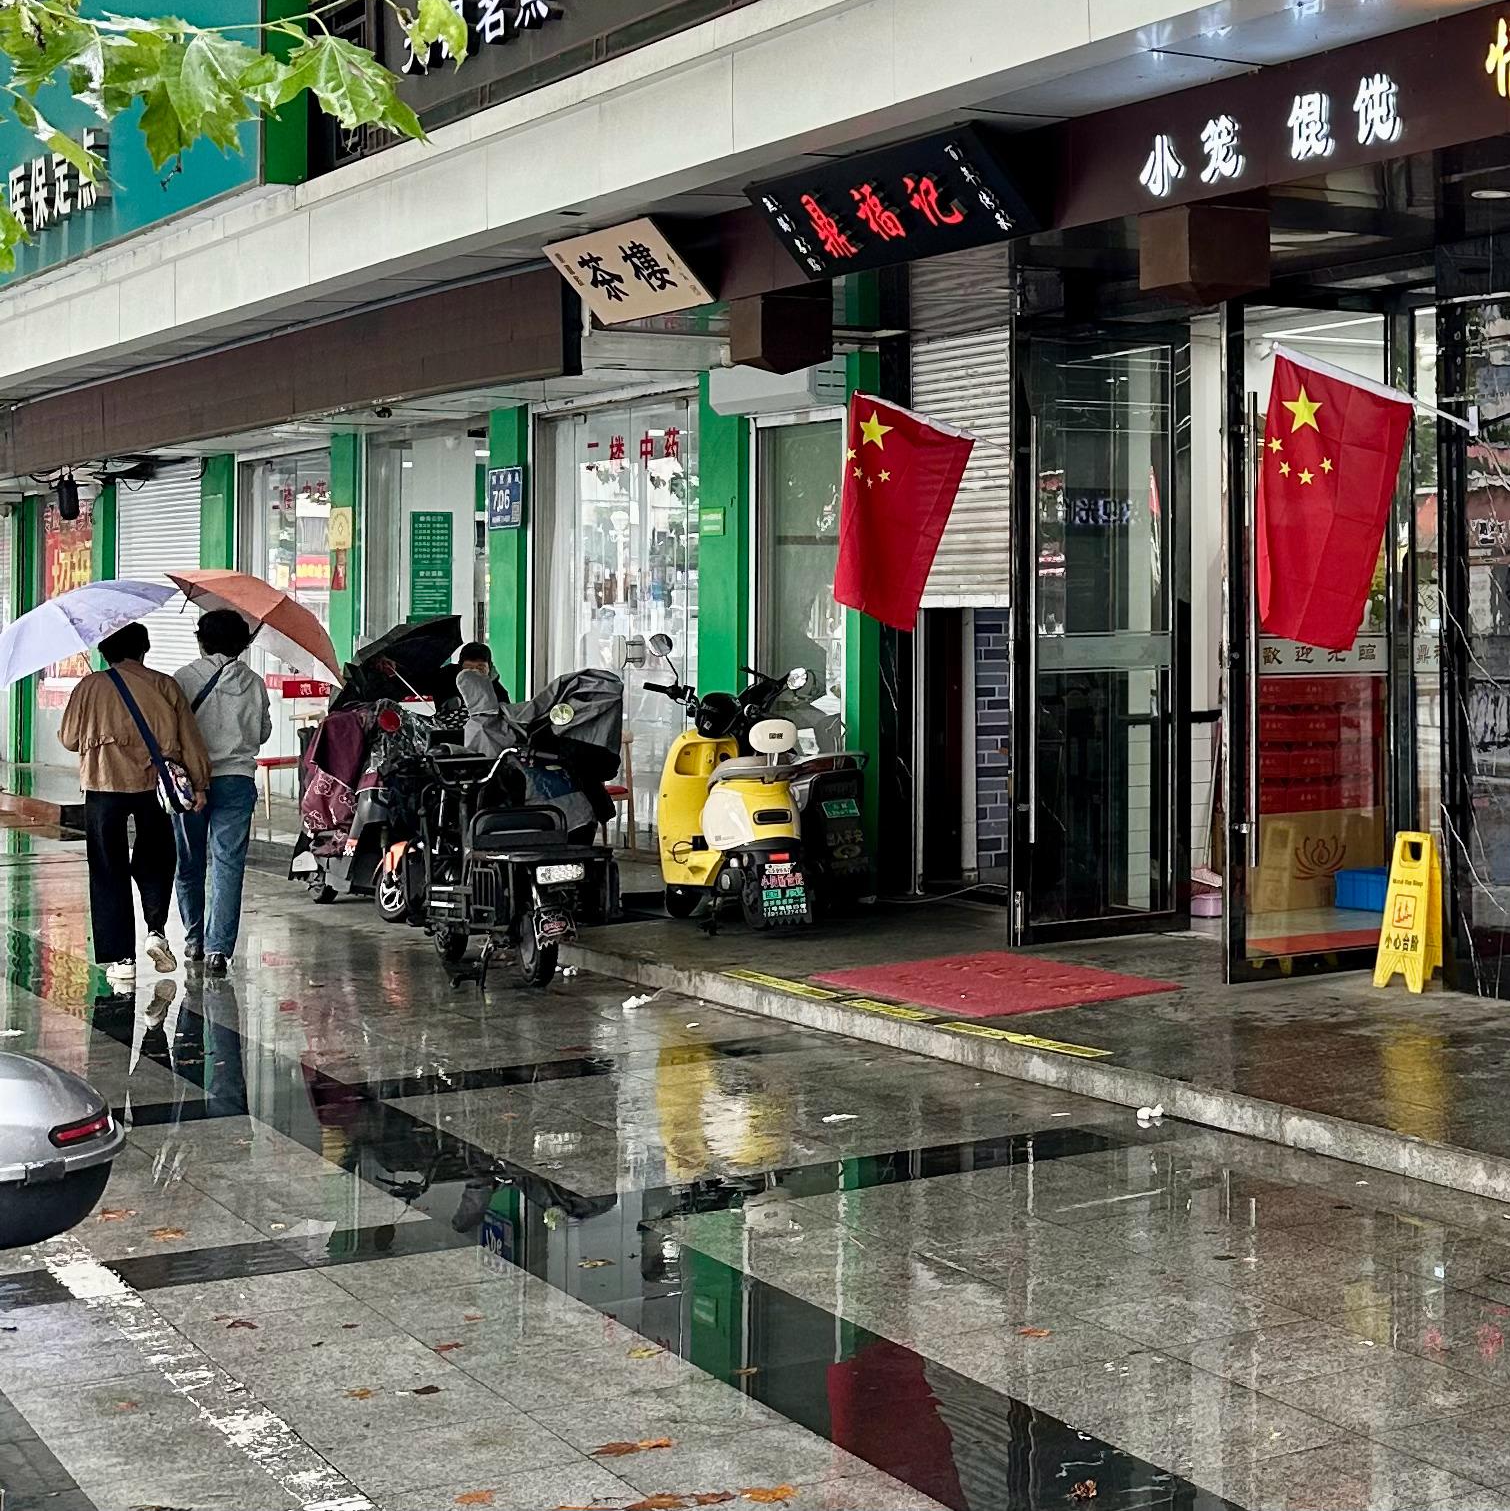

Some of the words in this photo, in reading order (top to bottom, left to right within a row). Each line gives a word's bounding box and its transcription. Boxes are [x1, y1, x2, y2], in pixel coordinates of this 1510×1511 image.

[1139, 73, 1400, 197] 小笼馄饨
[801, 176, 964, 258] 鼎福记
[577, 240, 678, 302] 茶樓
[492, 489, 511, 511] 706
